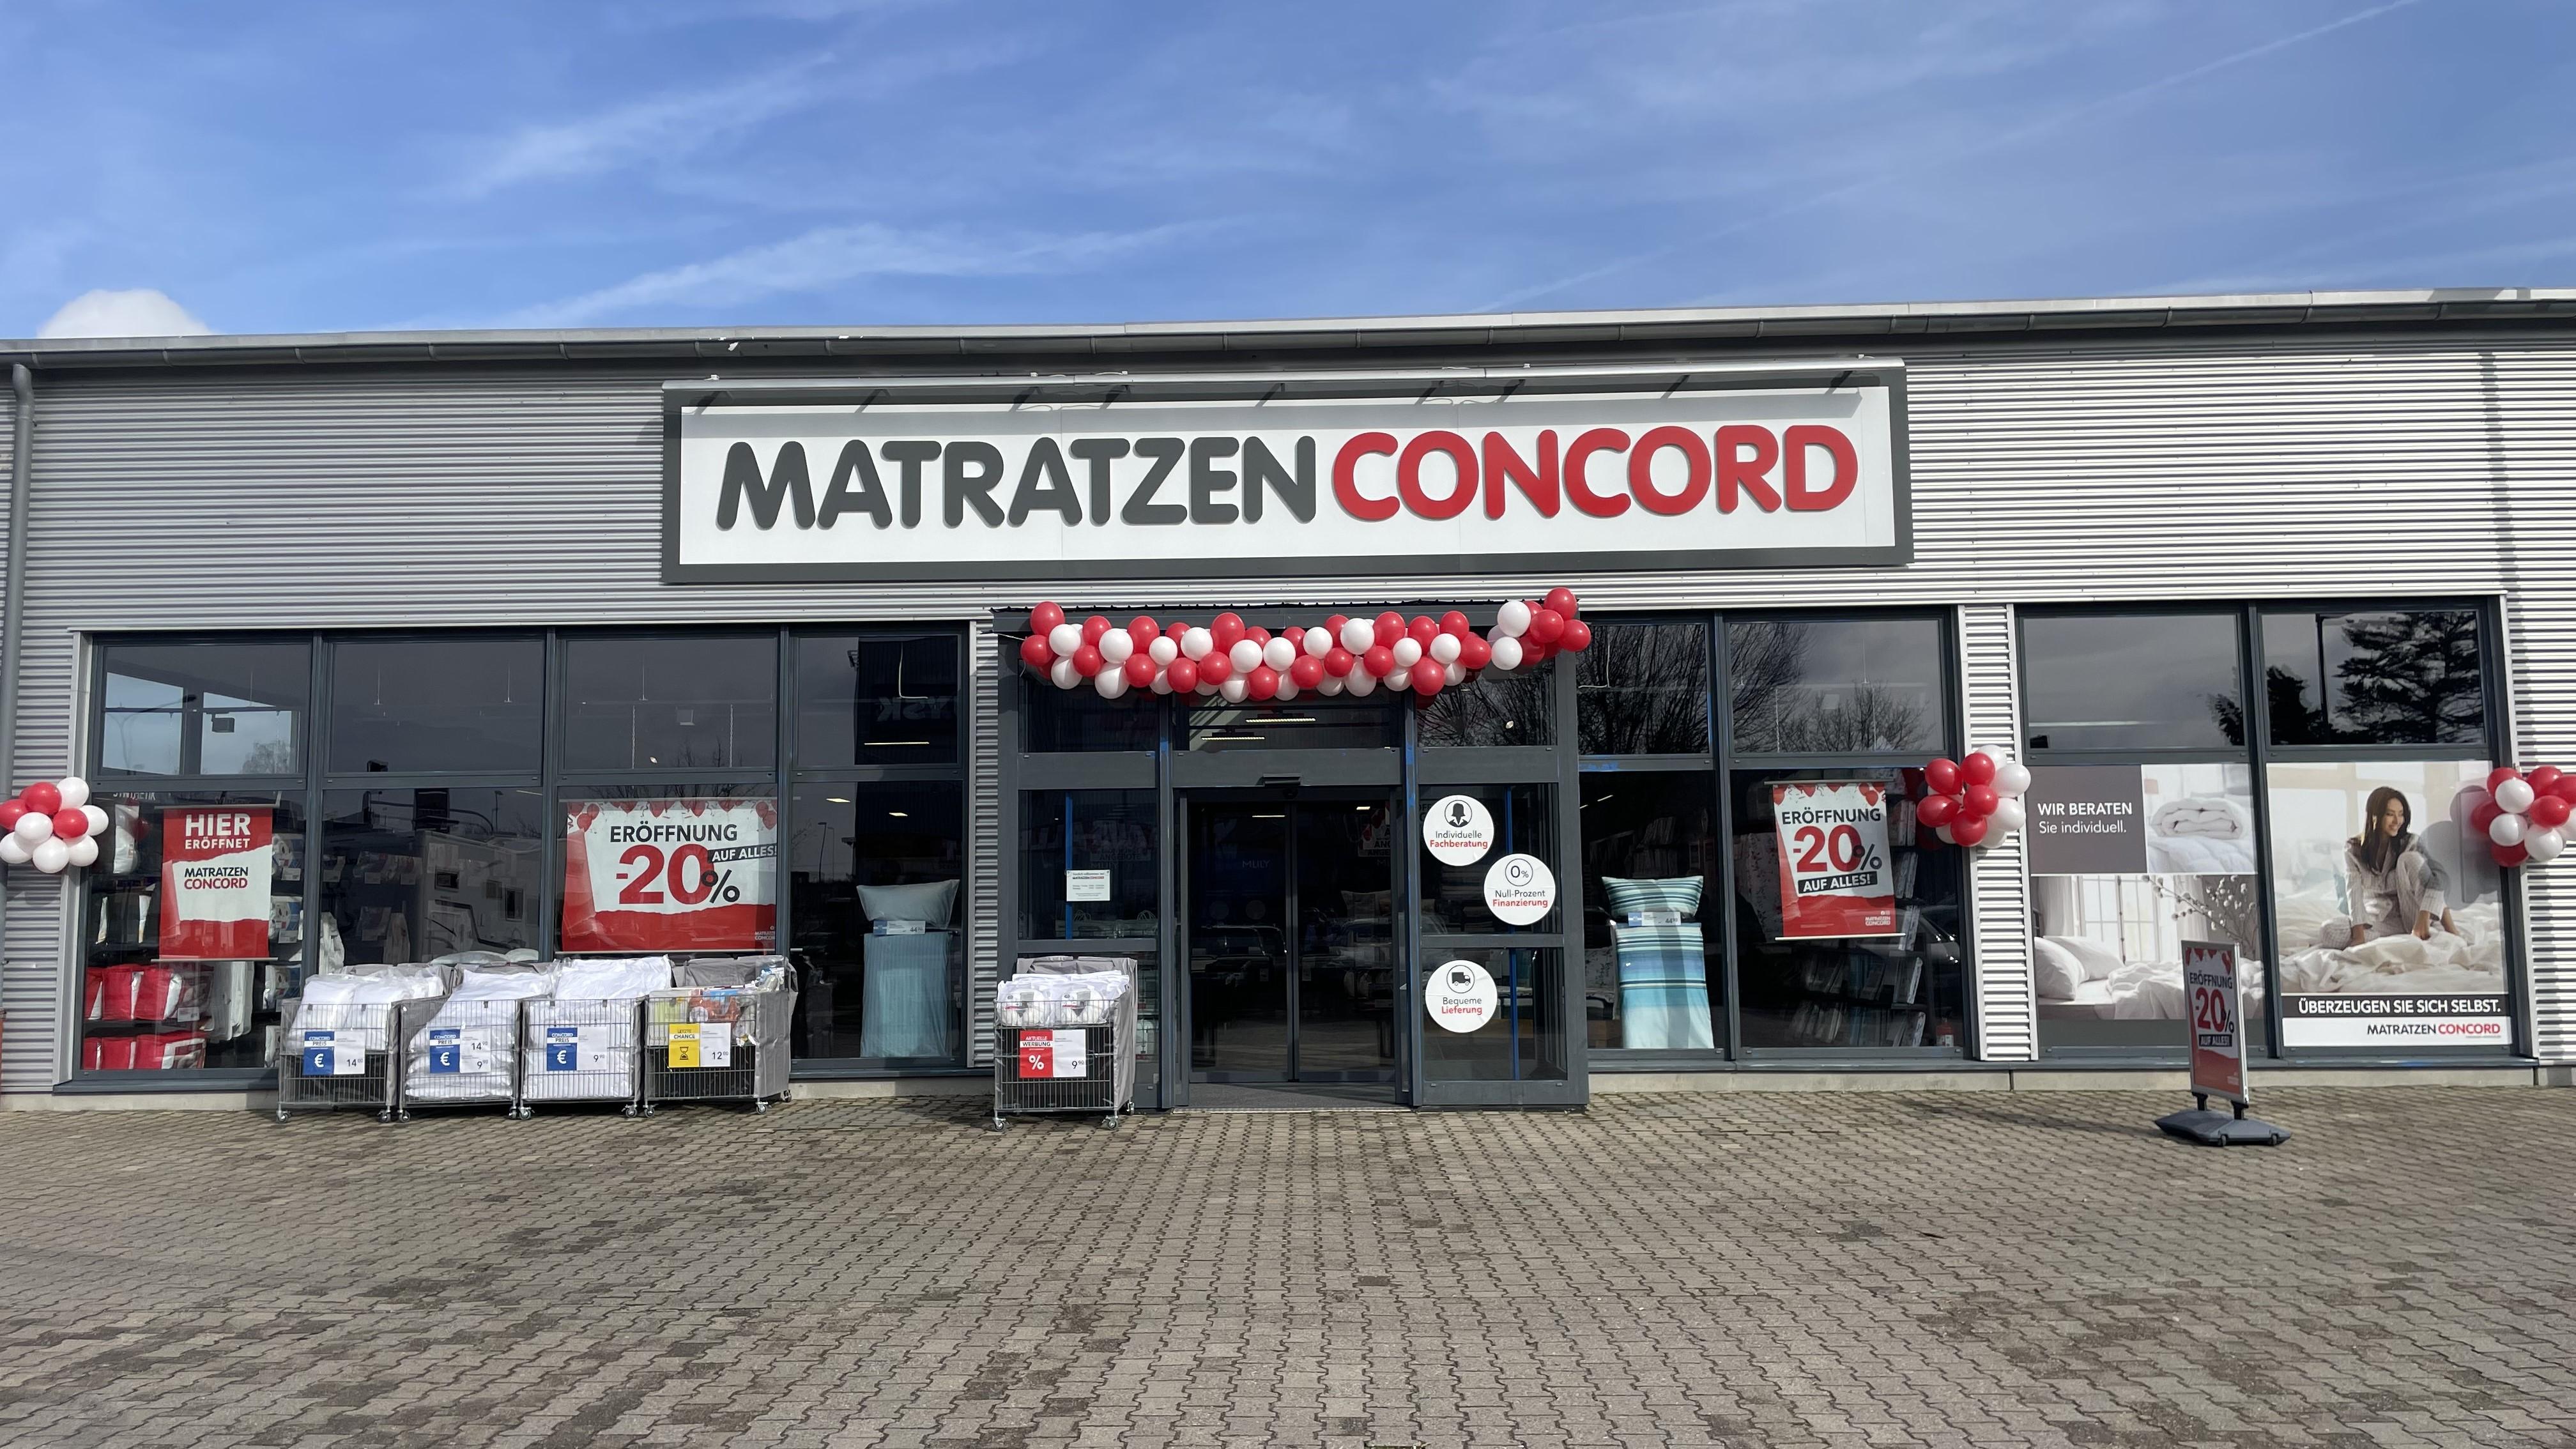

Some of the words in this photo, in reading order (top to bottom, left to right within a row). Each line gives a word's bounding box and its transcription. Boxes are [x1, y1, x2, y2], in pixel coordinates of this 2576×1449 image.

[716, 436, 1316, 530] MATRATZEN
[1332, 424, 1859, 521] CONCORD
[1781, 806, 1881, 824] ERÖFFNUNG
[2037, 802, 2065, 816] WIR
[2069, 802, 2133, 815] BERATEN
[185, 813, 251, 836] HIER
[610, 820, 738, 843] ERÖFFNUNG
[2039, 820, 2057, 834] Sie
[2061, 820, 2127, 834] individuell.
[185, 836, 250, 850] ERÖFFNET
[1430, 839, 1488, 849] Fachberatung
[712, 849, 736, 862] AUF
[738, 845, 778, 859] ALLES!
[184, 866, 249, 878] MATRATZEN
[1510, 865, 1529, 878] 0%
[184, 878, 248, 890] CONCORD
[1802, 879, 1828, 893] AUF
[1830, 873, 1871, 889] ALLES!
[1495, 889, 1545, 898] Null-Prozent
[1492, 899, 1548, 908] Finanzierung
[2189, 970, 2232, 988] ERÖFFNUNG
[1443, 997, 1482, 1006] Bequeme
[2299, 997, 2390, 1014] ÜBERZEUGEN
[2393, 1000, 2414, 1013] SIE
[2417, 999, 2448, 1013] SICH
[2451, 999, 2501, 1013] SELBST.
[1441, 1006, 1482, 1015] Lieferung
[2367, 1024, 2436, 1035] MATRATZEN
[2438, 1023, 2501, 1034] CONCORD
